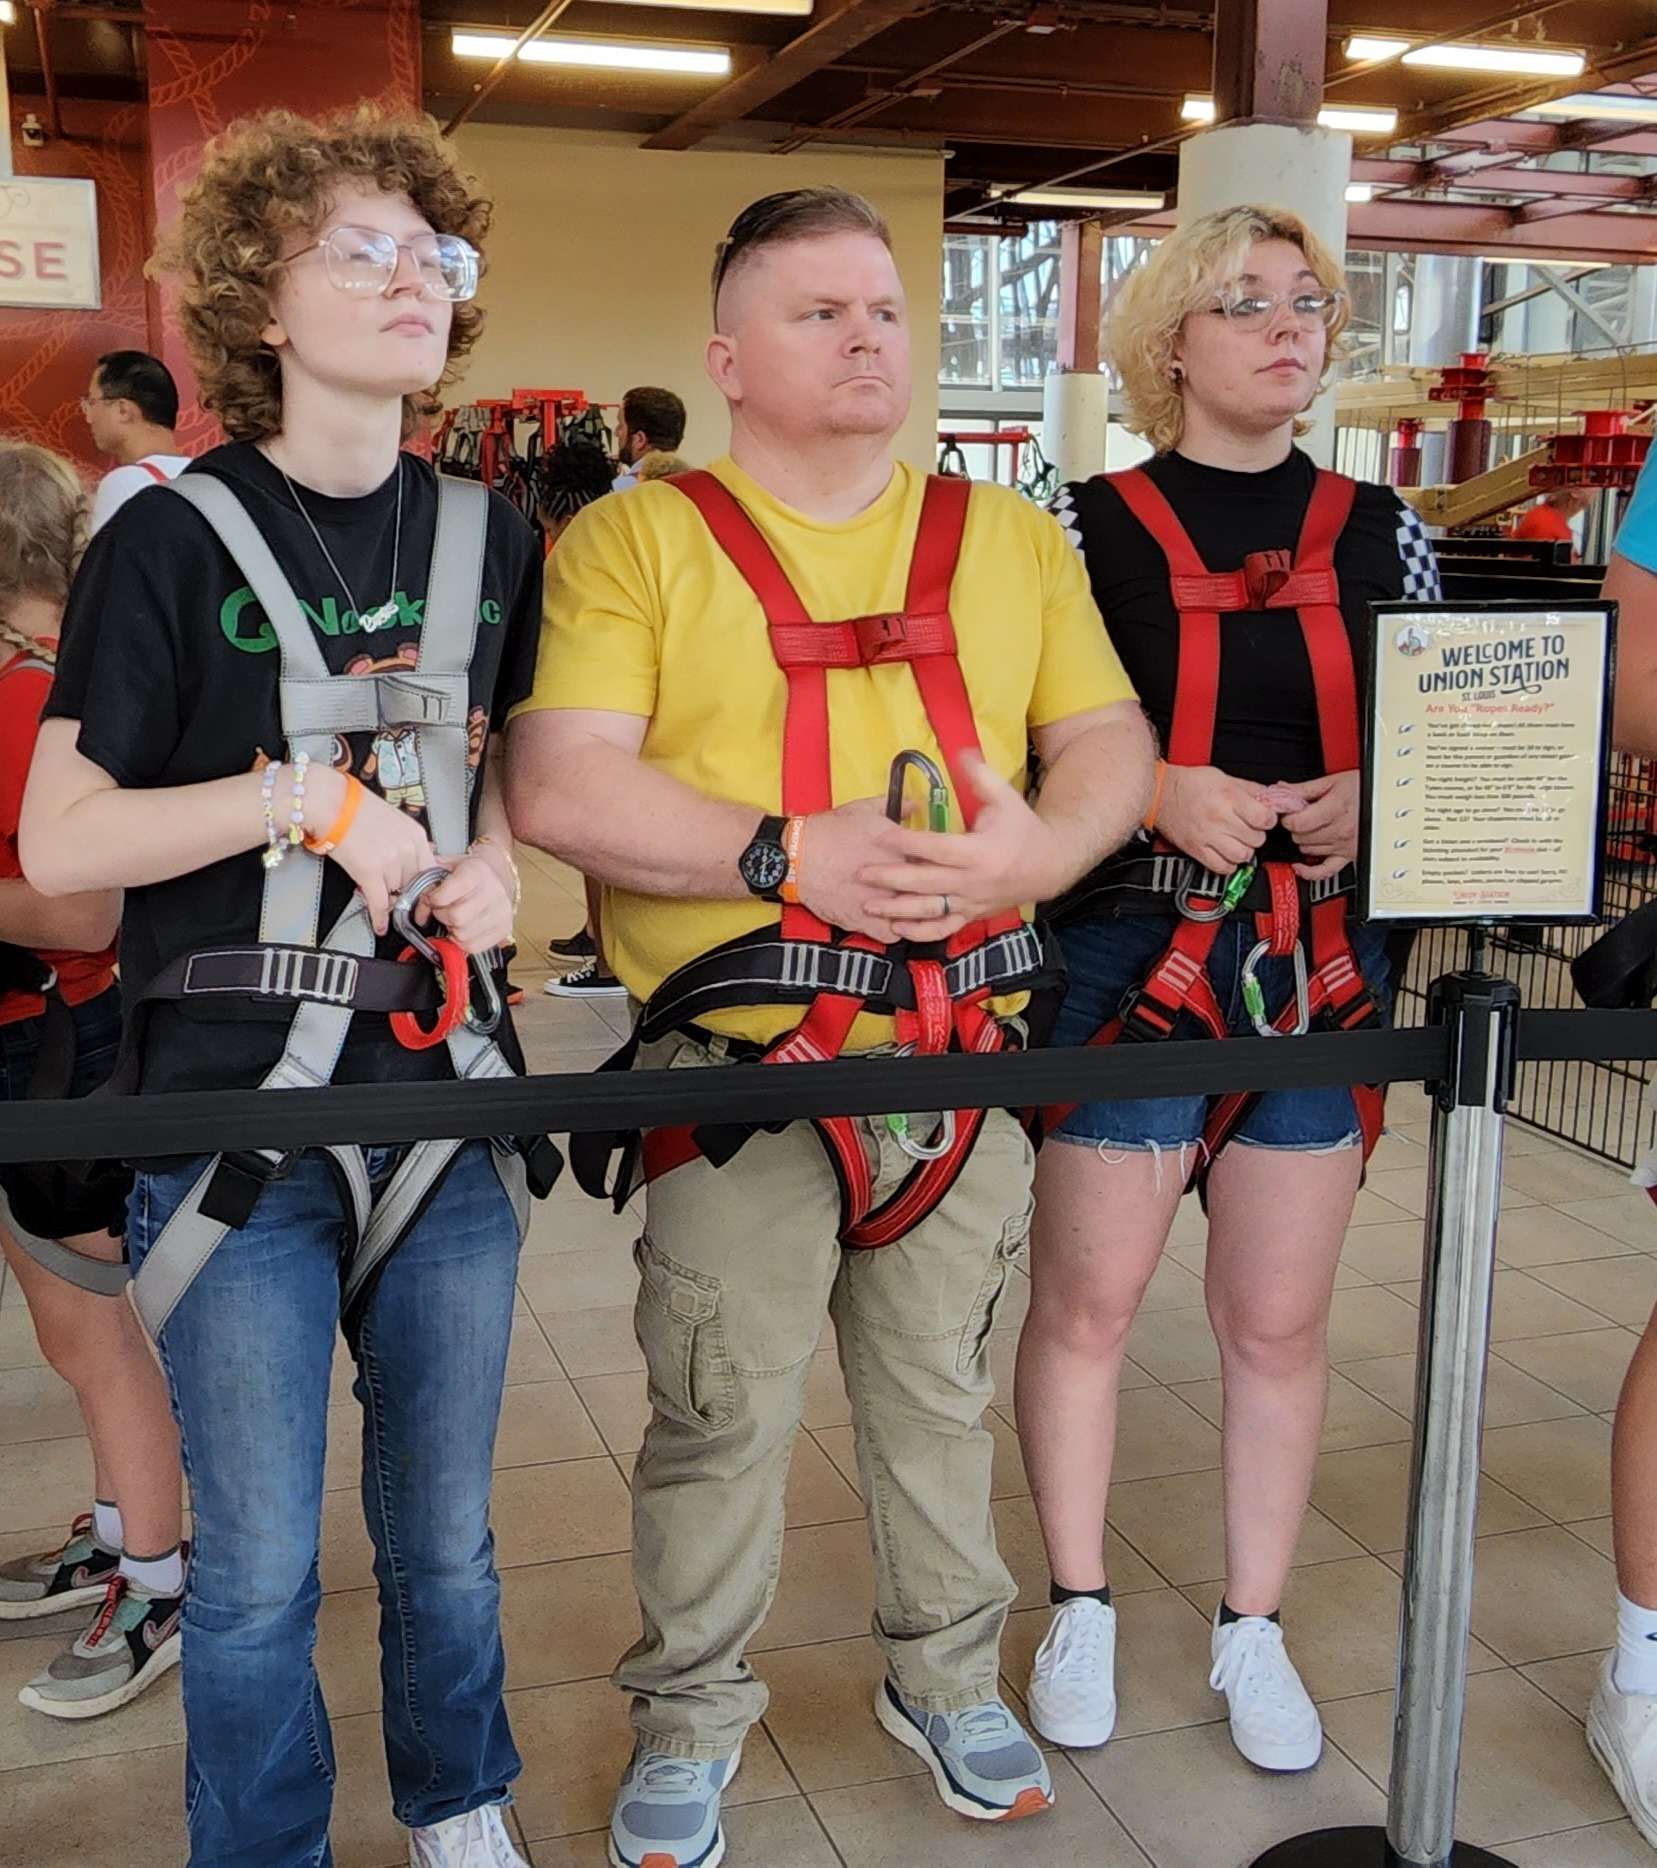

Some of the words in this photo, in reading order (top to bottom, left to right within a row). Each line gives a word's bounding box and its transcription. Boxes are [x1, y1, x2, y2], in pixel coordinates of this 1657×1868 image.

[1442, 637, 1536, 667] WELCOME
[1541, 634, 1565, 657] TO
[1418, 668, 1484, 694] UNION
[1489, 658, 1570, 692] STATION
[1473, 690, 1496, 701] LOUIS
[1425, 703, 1444, 713] Are
[1449, 703, 1468, 713] You
[1510, 702, 1555, 715] Ready?"
